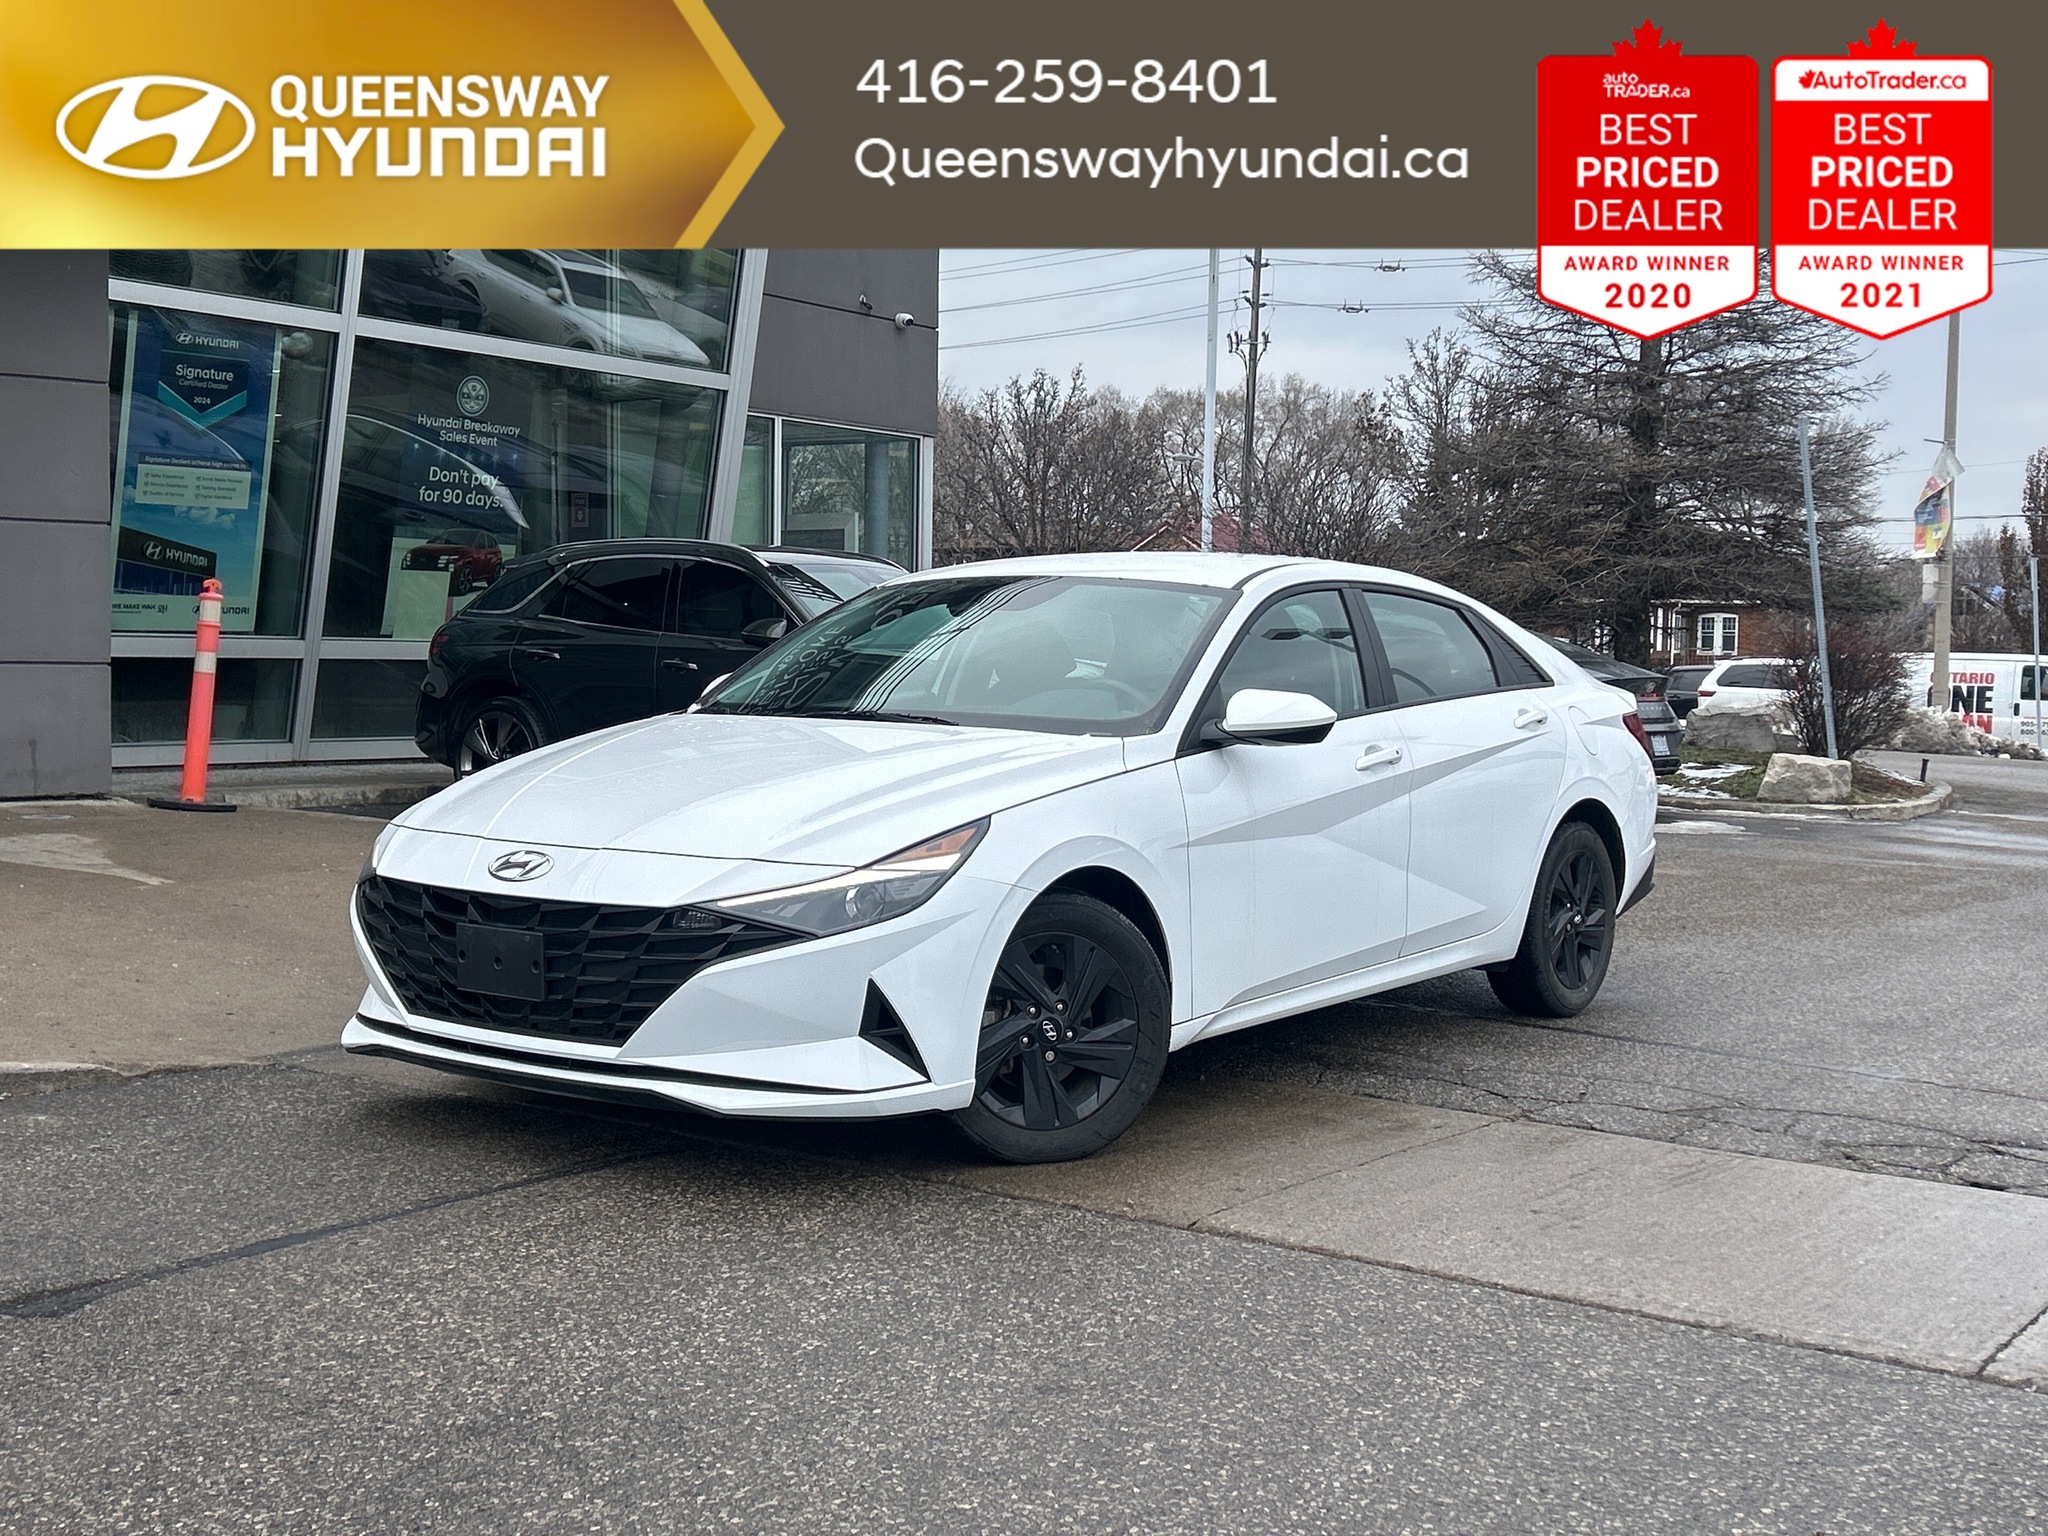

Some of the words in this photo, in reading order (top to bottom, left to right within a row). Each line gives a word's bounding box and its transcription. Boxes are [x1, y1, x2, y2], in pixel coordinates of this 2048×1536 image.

[195, 336, 240, 349] HYUNDAI
[175, 364, 234, 381] Signature
[417, 413, 462, 429] Hyundai
[463, 419, 521, 438] Breakaway
[439, 430, 468, 443] Sales
[469, 433, 498, 446] Event
[429, 466, 468, 484] Don't
[471, 473, 500, 489] pay
[419, 486, 440, 502] for
[442, 488, 463, 504] 90
[465, 490, 504, 509] days.
[166, 548, 208, 567] HYUNDAI
